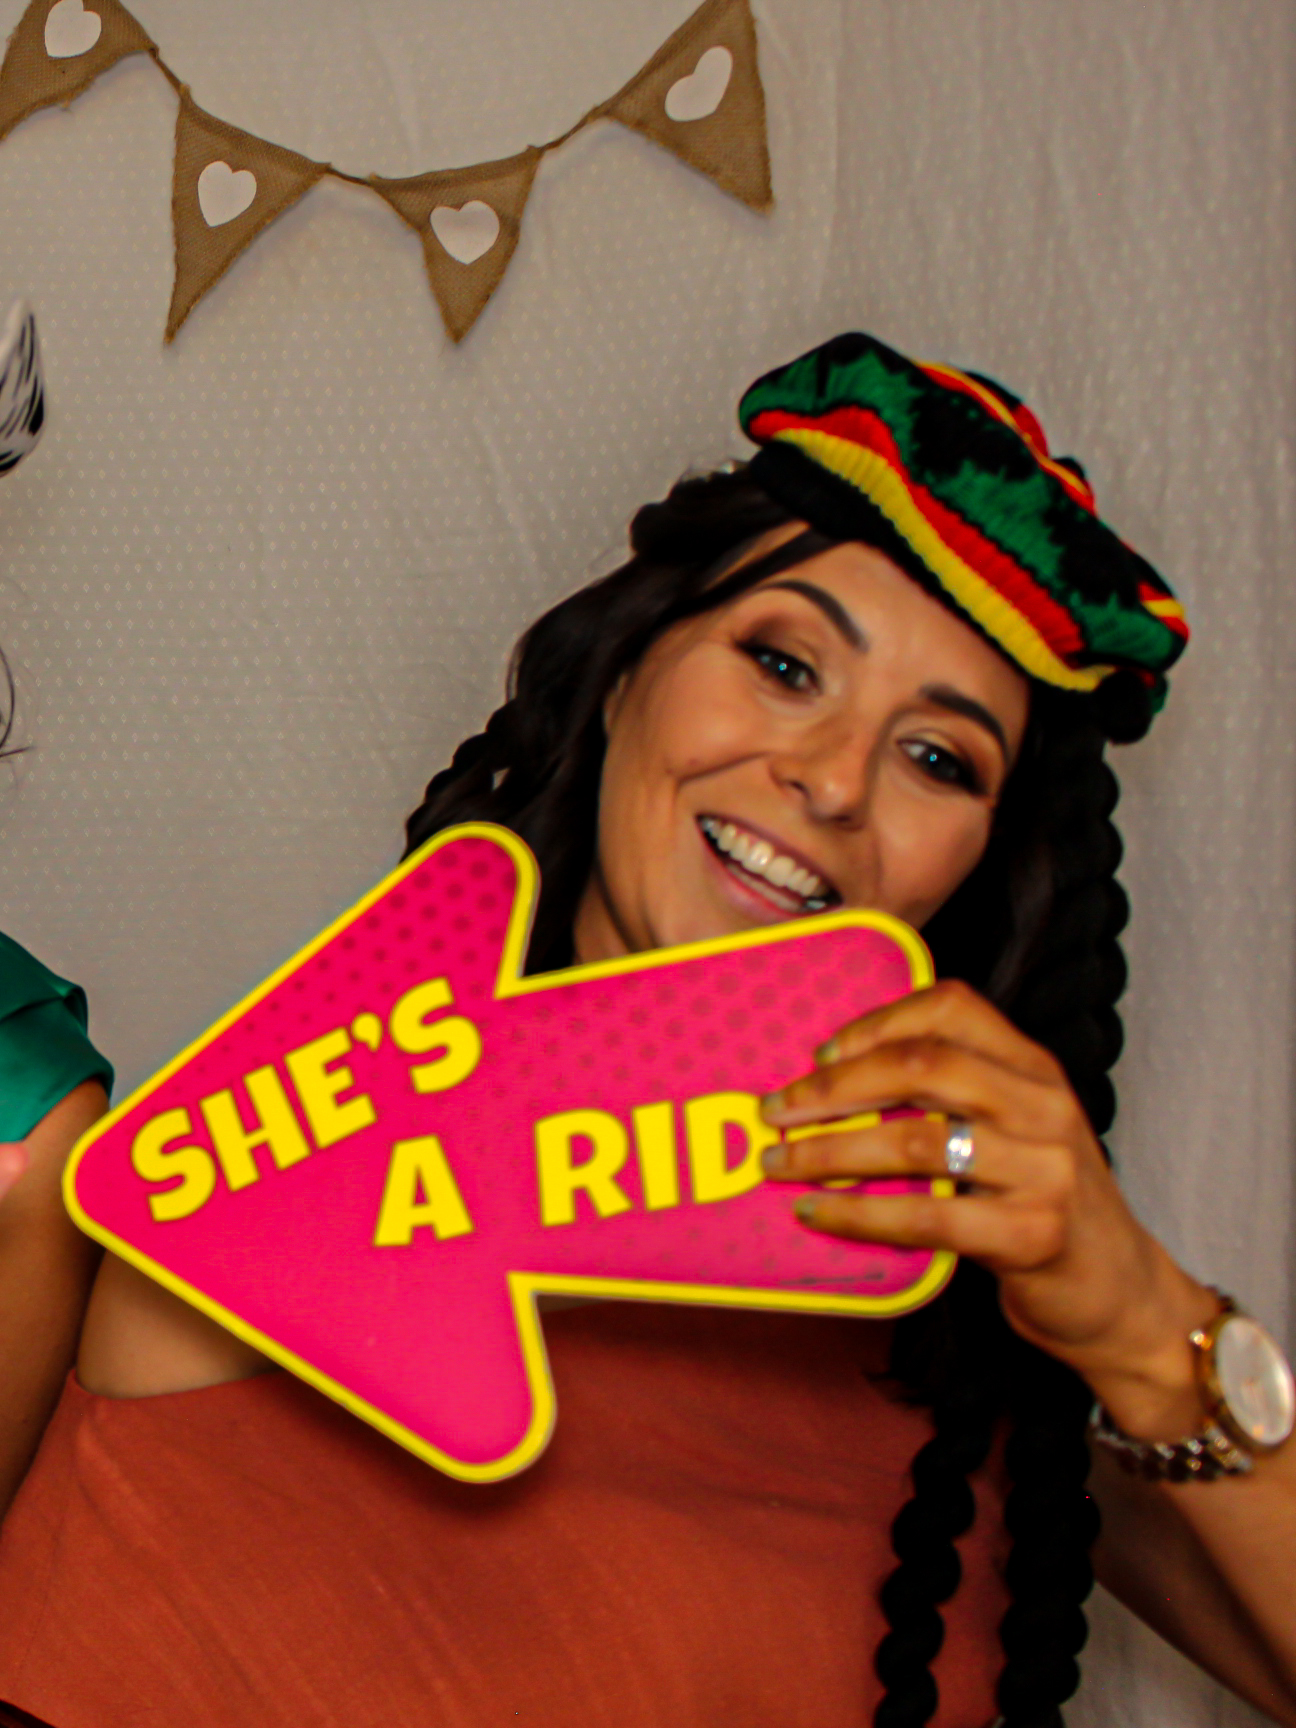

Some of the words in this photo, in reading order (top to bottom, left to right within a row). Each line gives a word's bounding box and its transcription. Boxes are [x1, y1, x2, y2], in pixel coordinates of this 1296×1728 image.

[130, 977, 483, 1222] SHE'S
[373, 1134, 474, 1247] A
[533, 1089, 882, 1227] RID
